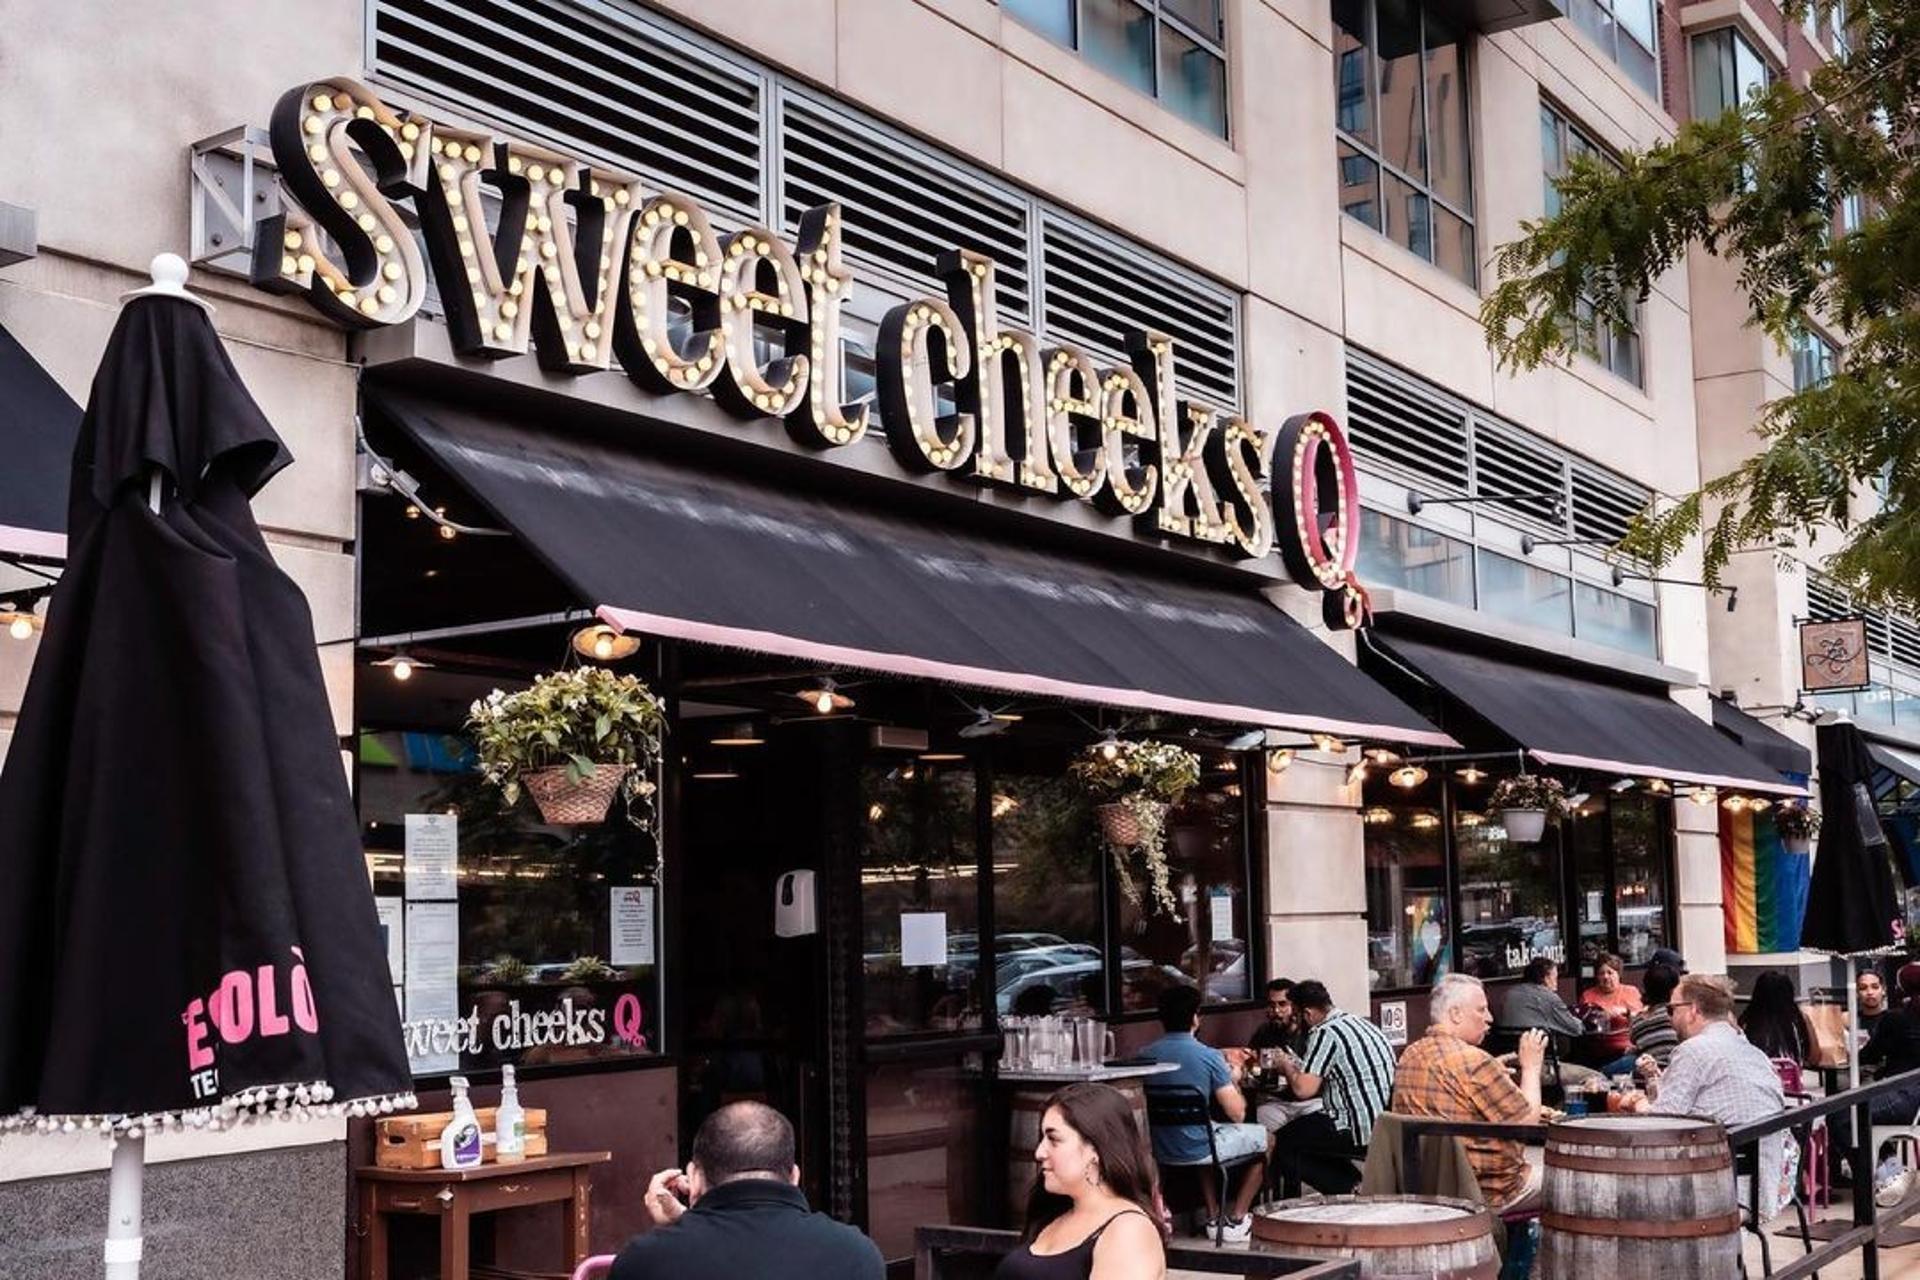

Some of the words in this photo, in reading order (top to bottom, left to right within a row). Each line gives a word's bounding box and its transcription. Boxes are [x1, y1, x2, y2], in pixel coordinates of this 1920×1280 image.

[877, 249, 1271, 561] cheeks
[1272, 411, 1373, 631] Q
[402, 1004, 484, 1057] weet
[491, 997, 605, 1051] cheeks
[614, 993, 646, 1048] Q
